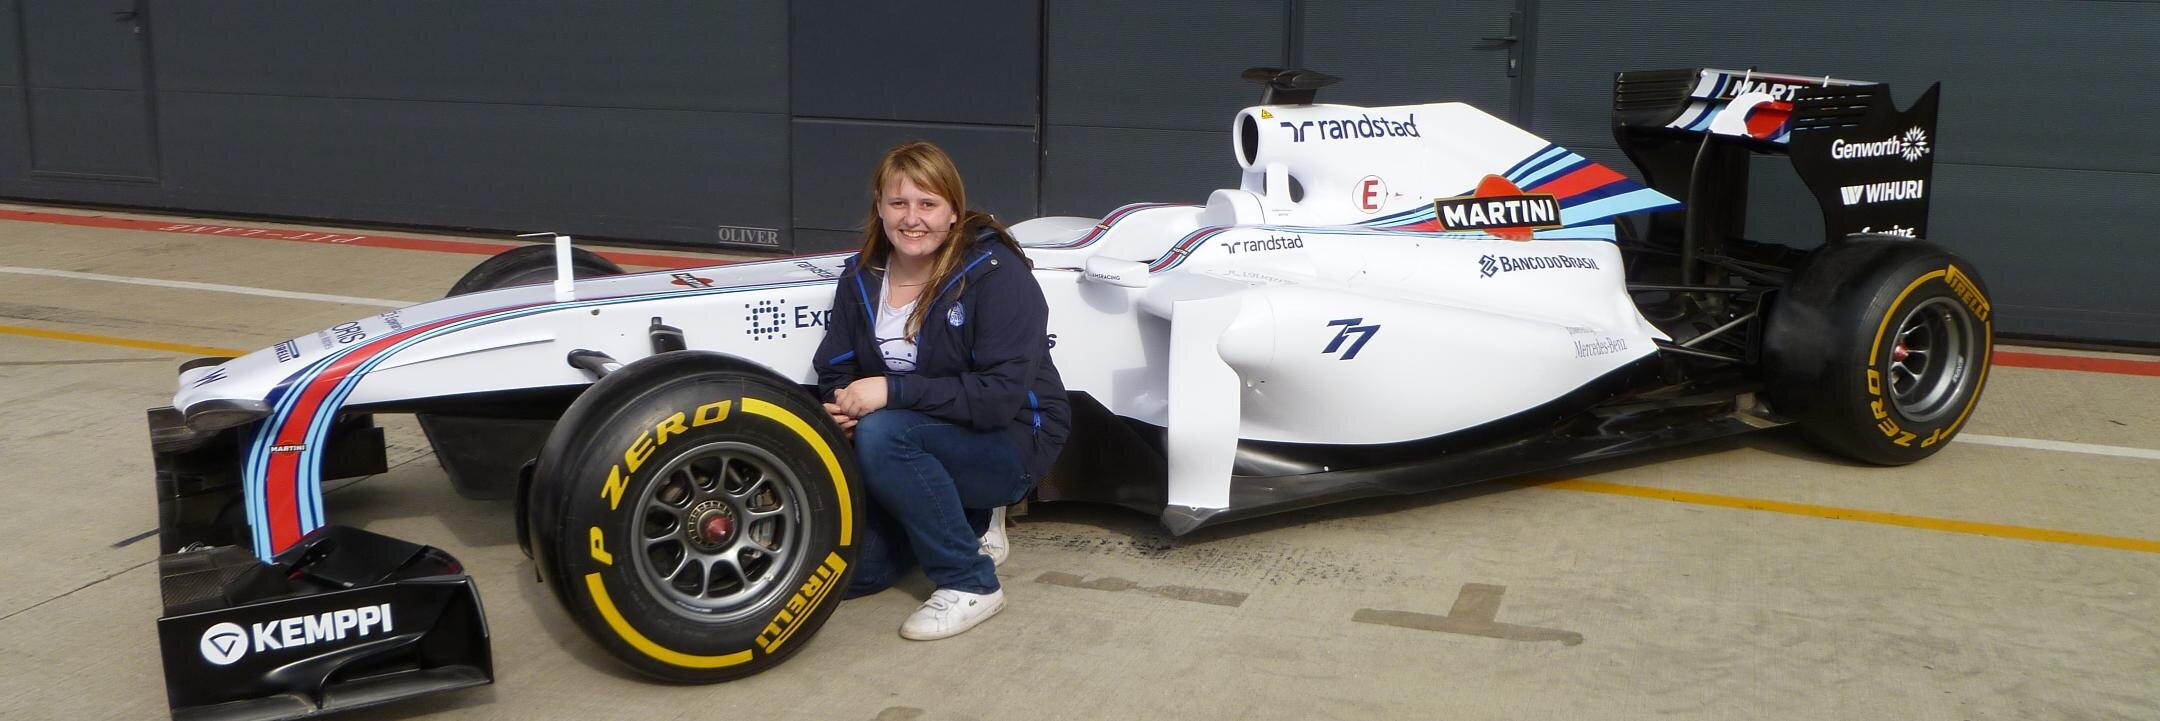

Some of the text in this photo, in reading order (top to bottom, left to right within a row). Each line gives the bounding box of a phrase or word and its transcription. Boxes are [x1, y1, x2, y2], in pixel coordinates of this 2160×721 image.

[1318, 113, 1421, 140] randstad
[1831, 135, 1901, 160] Genworth
[1362, 179, 1378, 209] E
[1865, 180, 1924, 203] WIHURI
[1443, 198, 1555, 228] MARTINI
[719, 227, 779, 244] OLIVER
[1243, 234, 1304, 253] randstad
[1944, 263, 1991, 323] PIRELLI
[794, 305, 832, 331] Exp
[1321, 317, 1381, 361] 77
[1573, 336, 1629, 359] Mercedes-Benz
[1866, 368, 1919, 448] ZERO
[601, 399, 732, 511] ZERO
[590, 526, 613, 566] P
[754, 551, 848, 655] PIRELLI
[252, 602, 393, 652] KEMPPI
